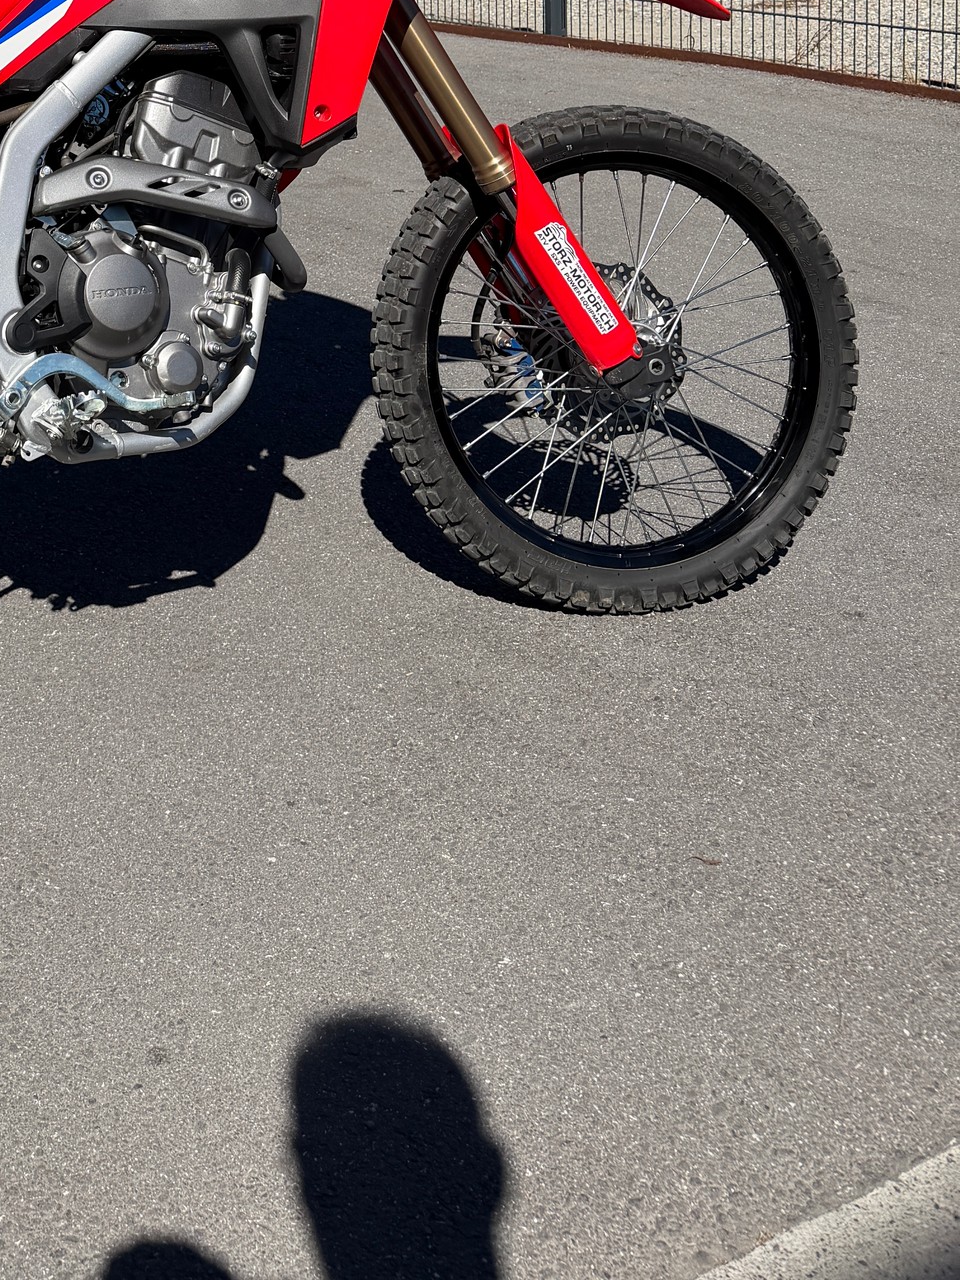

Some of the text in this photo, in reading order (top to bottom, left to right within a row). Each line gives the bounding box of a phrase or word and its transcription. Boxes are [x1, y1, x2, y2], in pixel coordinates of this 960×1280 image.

[92, 285, 153, 299] HONDA
[537, 233, 549, 246] ATV
[564, 272, 582, 297] POWER
[580, 296, 607, 333] EQUIPMENT
[542, 226, 614, 331] STORZ-MOTOR.CH
